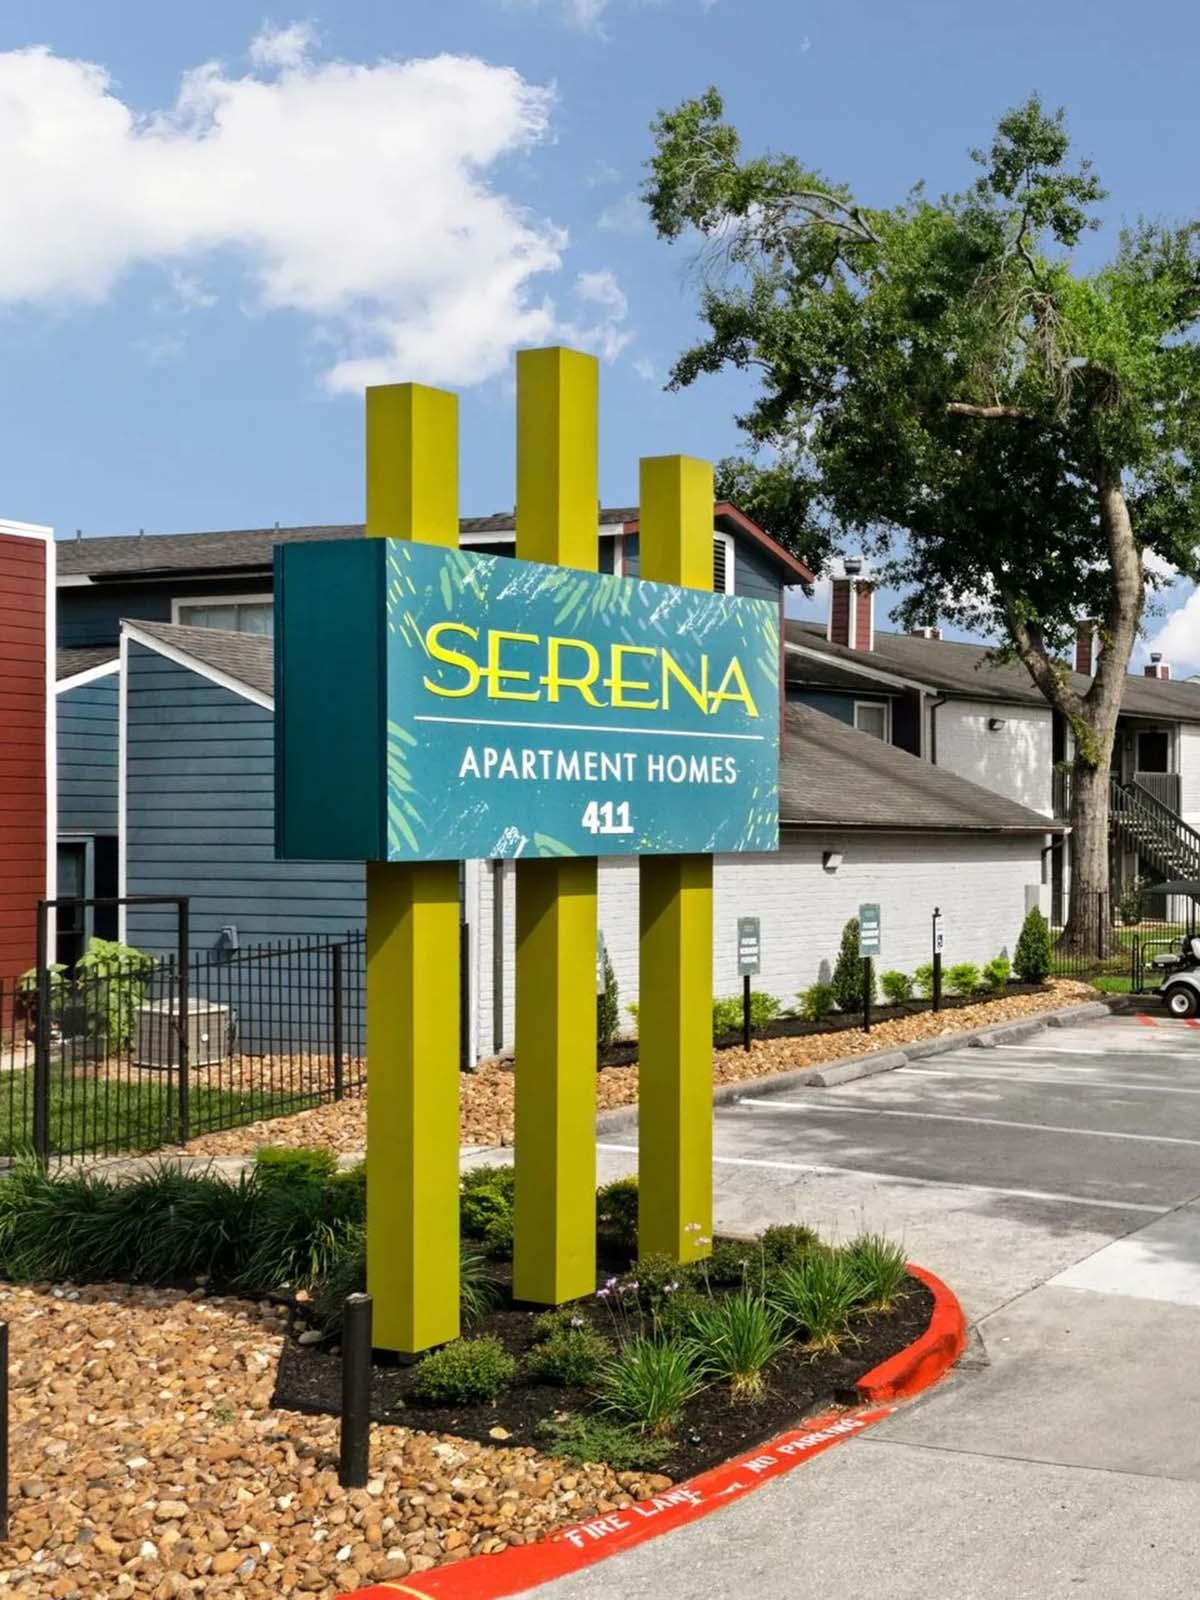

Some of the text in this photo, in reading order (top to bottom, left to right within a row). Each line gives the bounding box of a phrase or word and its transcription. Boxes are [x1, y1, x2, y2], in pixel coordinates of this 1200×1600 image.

[423, 621, 760, 718] SERENA
[458, 746, 738, 785] APARTMENT HOMES
[581, 800, 635, 835] 411
[563, 1417, 866, 1548] FIRE LANE NO PARKING
